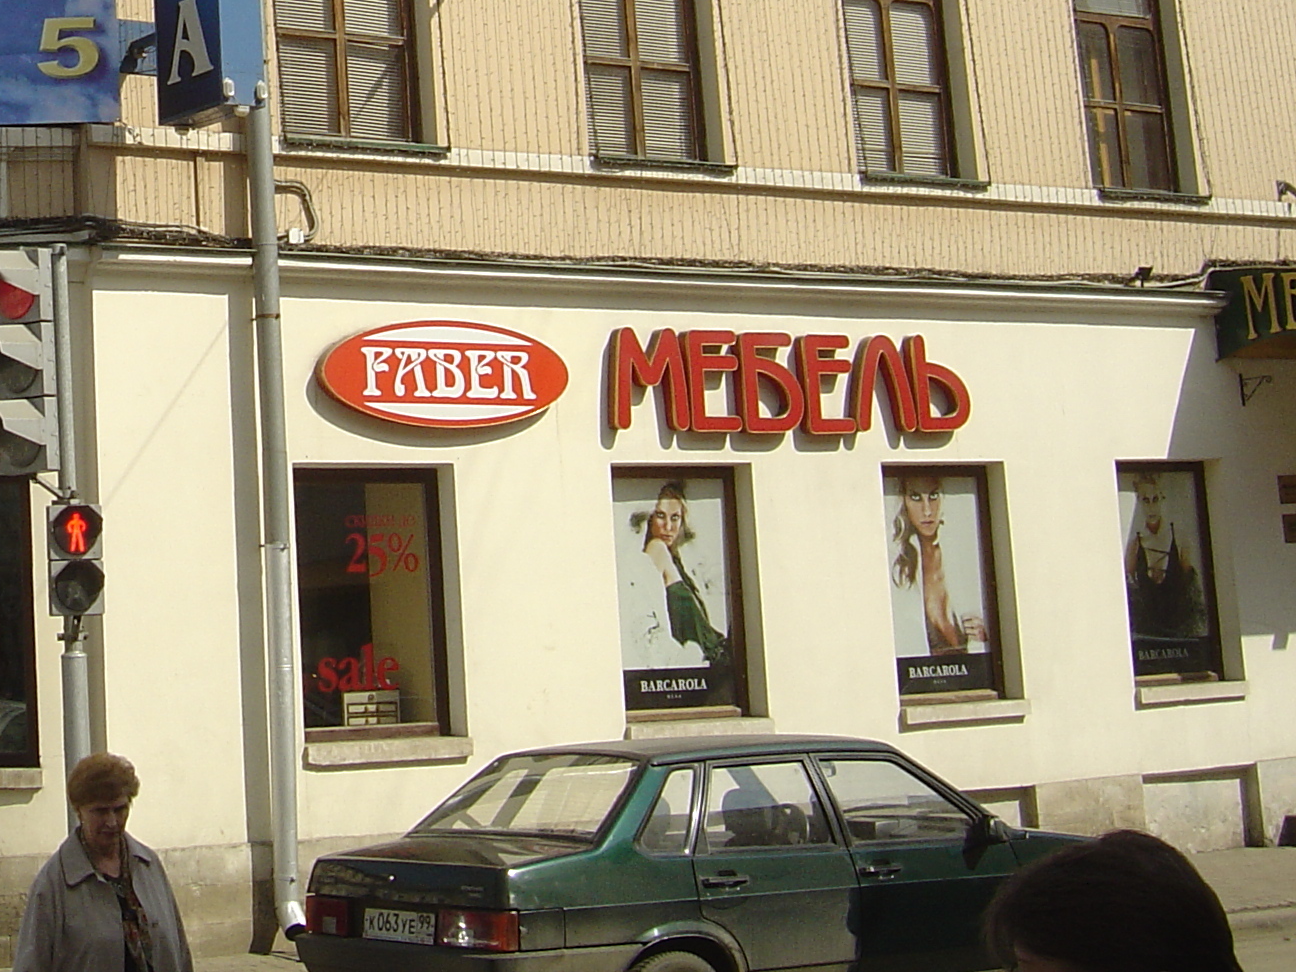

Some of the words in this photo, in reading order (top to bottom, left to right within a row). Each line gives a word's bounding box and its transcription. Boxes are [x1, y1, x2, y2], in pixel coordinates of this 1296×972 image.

[360, 346, 537, 399] FABER
[604, 326, 972, 434] МЕБЕЛЬ
[345, 532, 420, 578] 25%
[317, 643, 400, 694] sale
[640, 678, 708, 693] BARCAROLA
[908, 664, 969, 679] BARCAROLA
[418, 914, 431, 930] 99
